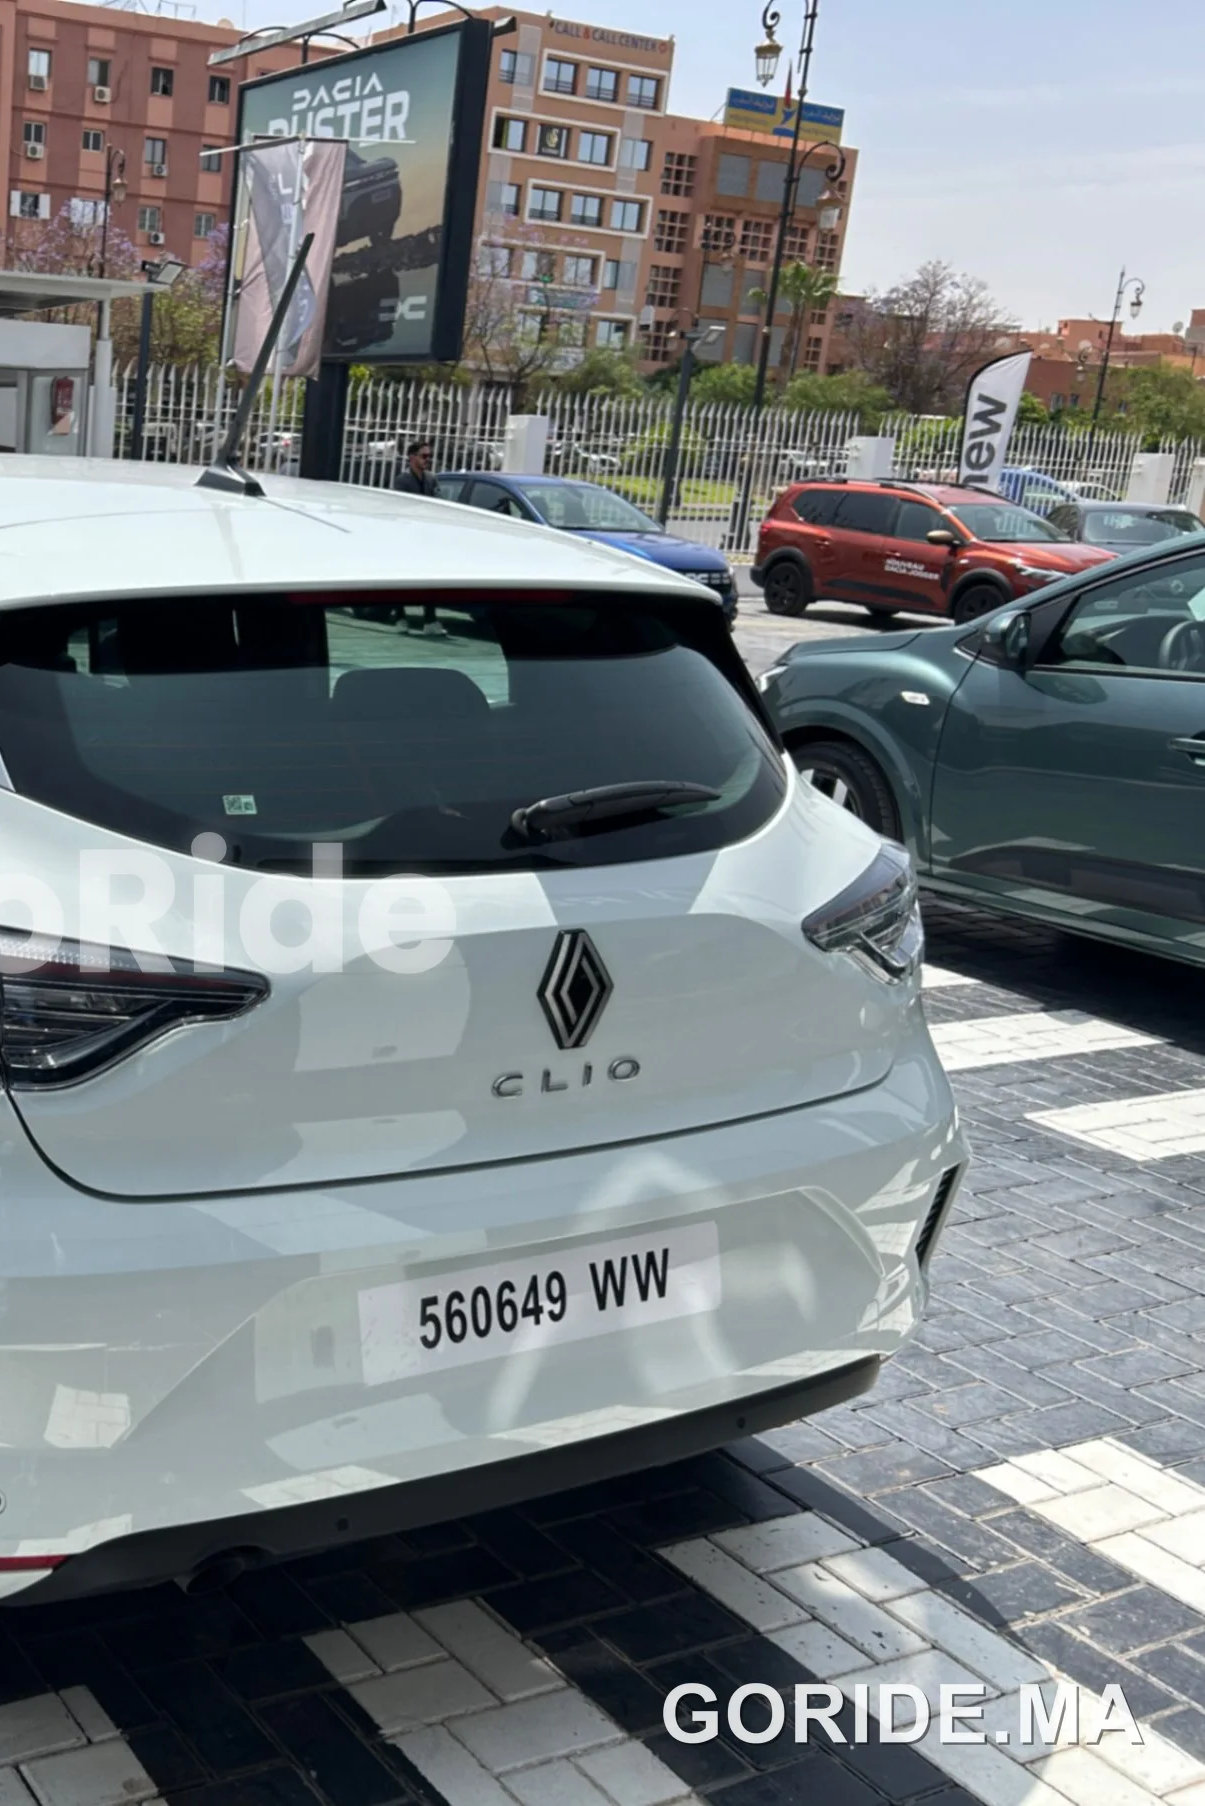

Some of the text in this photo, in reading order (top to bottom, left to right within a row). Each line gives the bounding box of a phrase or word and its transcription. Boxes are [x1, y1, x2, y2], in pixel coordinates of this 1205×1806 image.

[292, 72, 384, 111] DACIA
[491, 1061, 640, 1099] CLIO
[419, 1248, 669, 1349] 560649 WW
